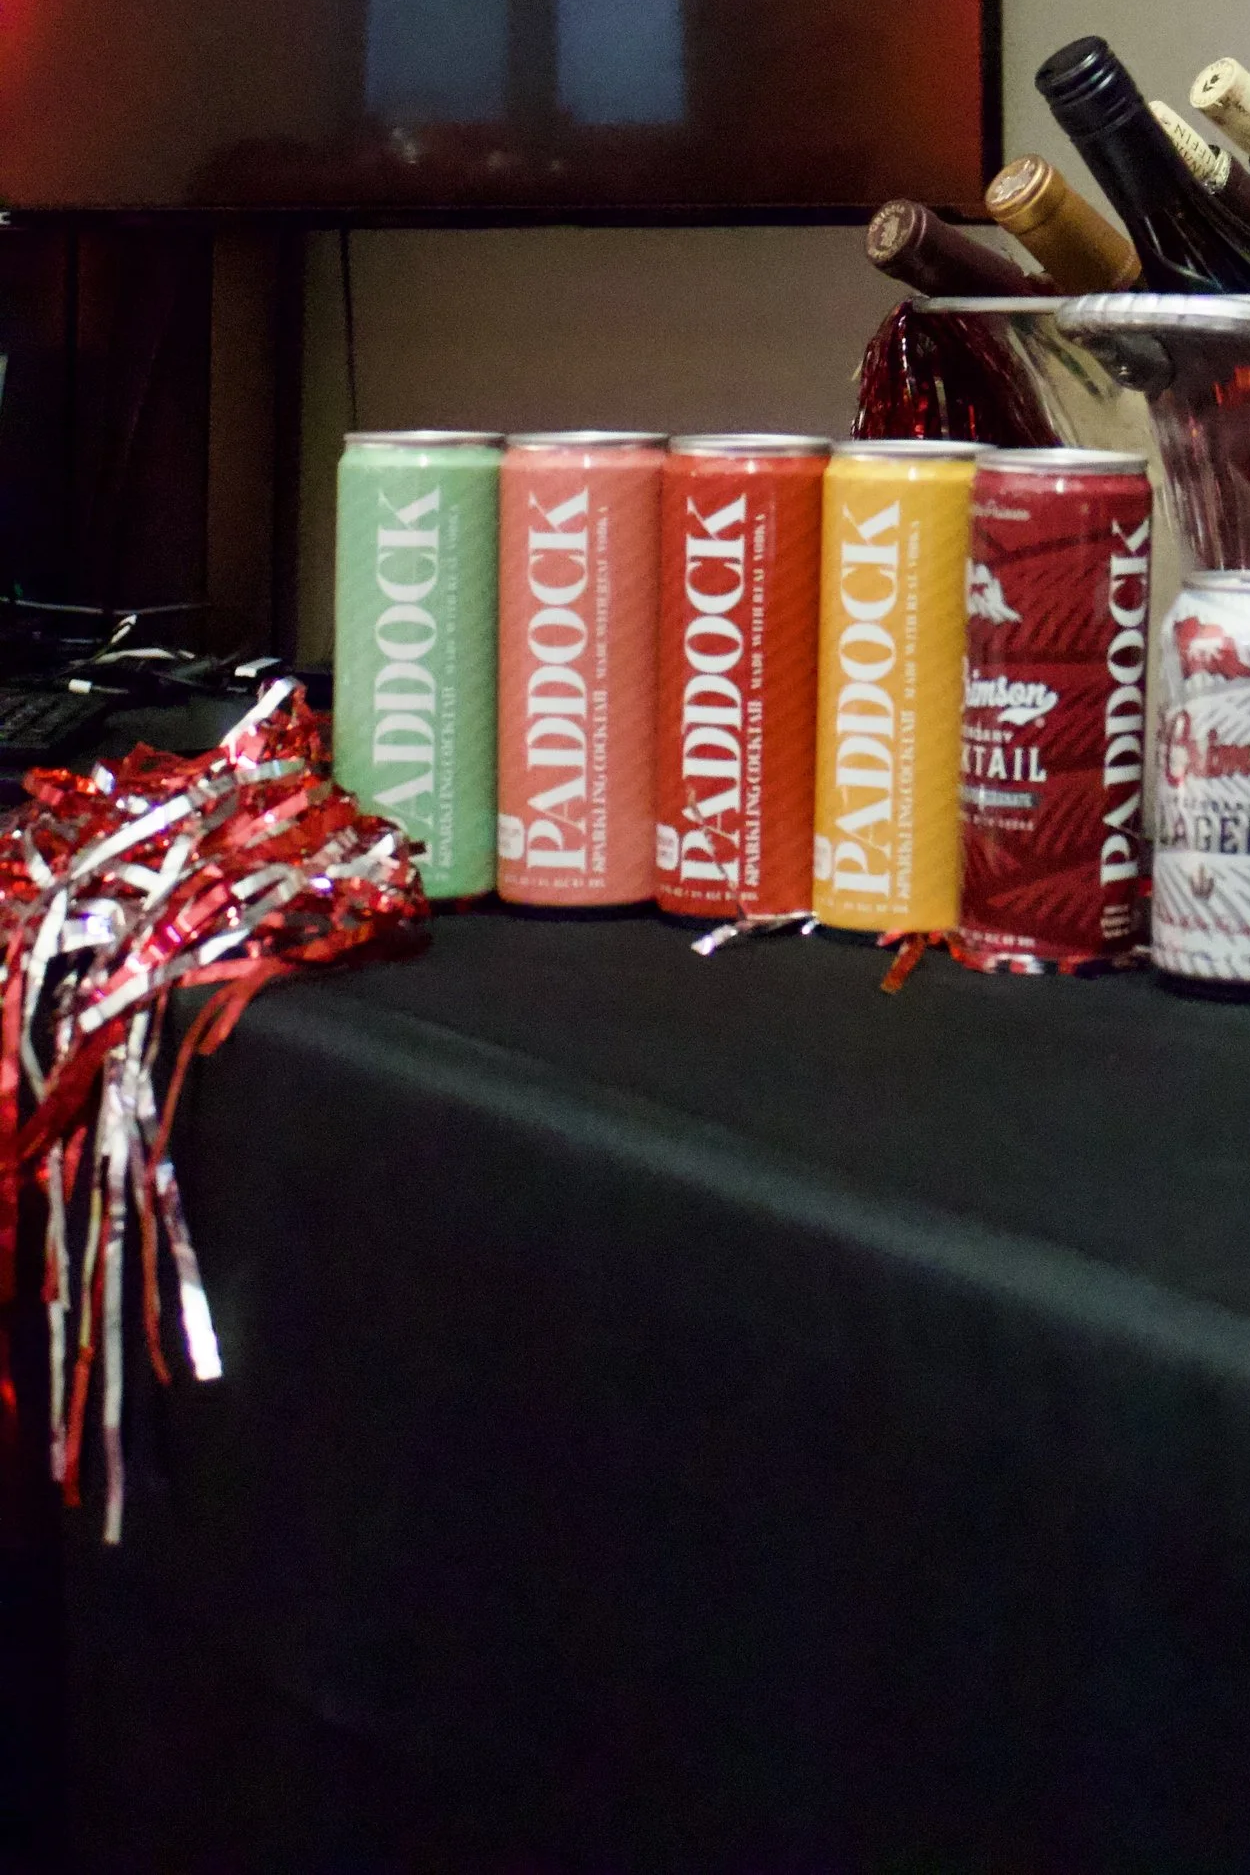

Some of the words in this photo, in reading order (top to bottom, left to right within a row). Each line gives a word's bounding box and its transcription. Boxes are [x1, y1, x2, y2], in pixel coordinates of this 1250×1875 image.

[526, 486, 590, 873] PADDOCK
[681, 494, 746, 887] PADDOCK
[834, 501, 900, 898] PADDOCK
[1100, 517, 1150, 885] PADDOCK
